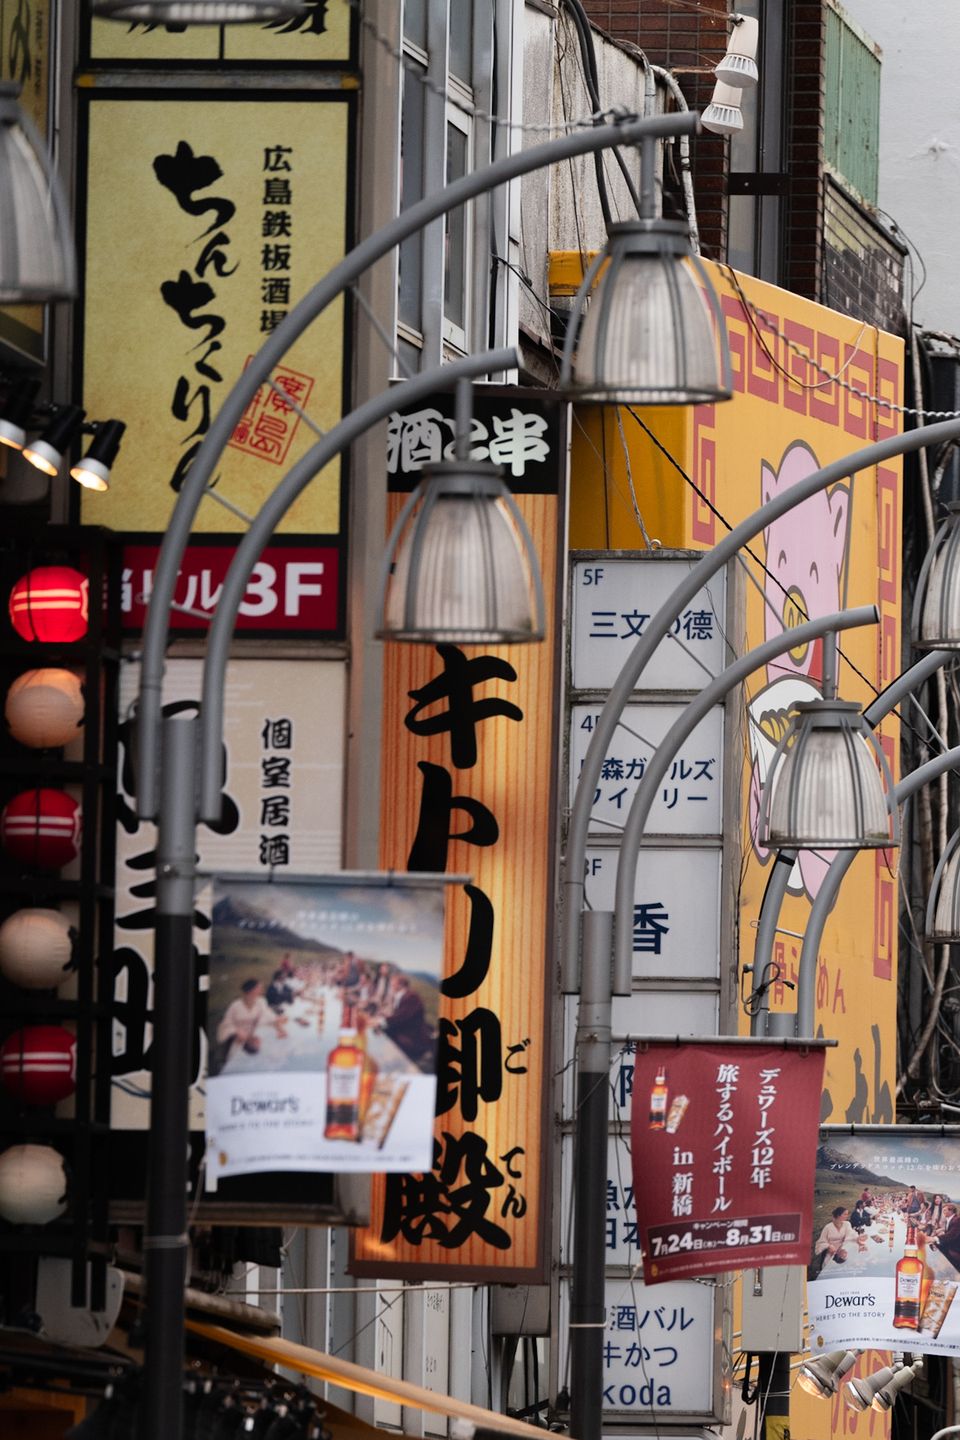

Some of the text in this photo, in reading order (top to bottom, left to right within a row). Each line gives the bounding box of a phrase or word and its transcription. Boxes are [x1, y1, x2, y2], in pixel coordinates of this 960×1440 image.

[582, 569, 604, 585] 5F
[504, 1037, 530, 1076] ご
[230, 1095, 300, 1117] Dewar's
[711, 1063, 741, 1214] 旅するハイボール
[751, 1067, 782, 1190] デュワーズ12年
[499, 1145, 528, 1219] てん
[671, 1147, 695, 1217] in 新橋
[825, 1292, 876, 1309] Dewar's
[863, 1310, 886, 1318] STORY
